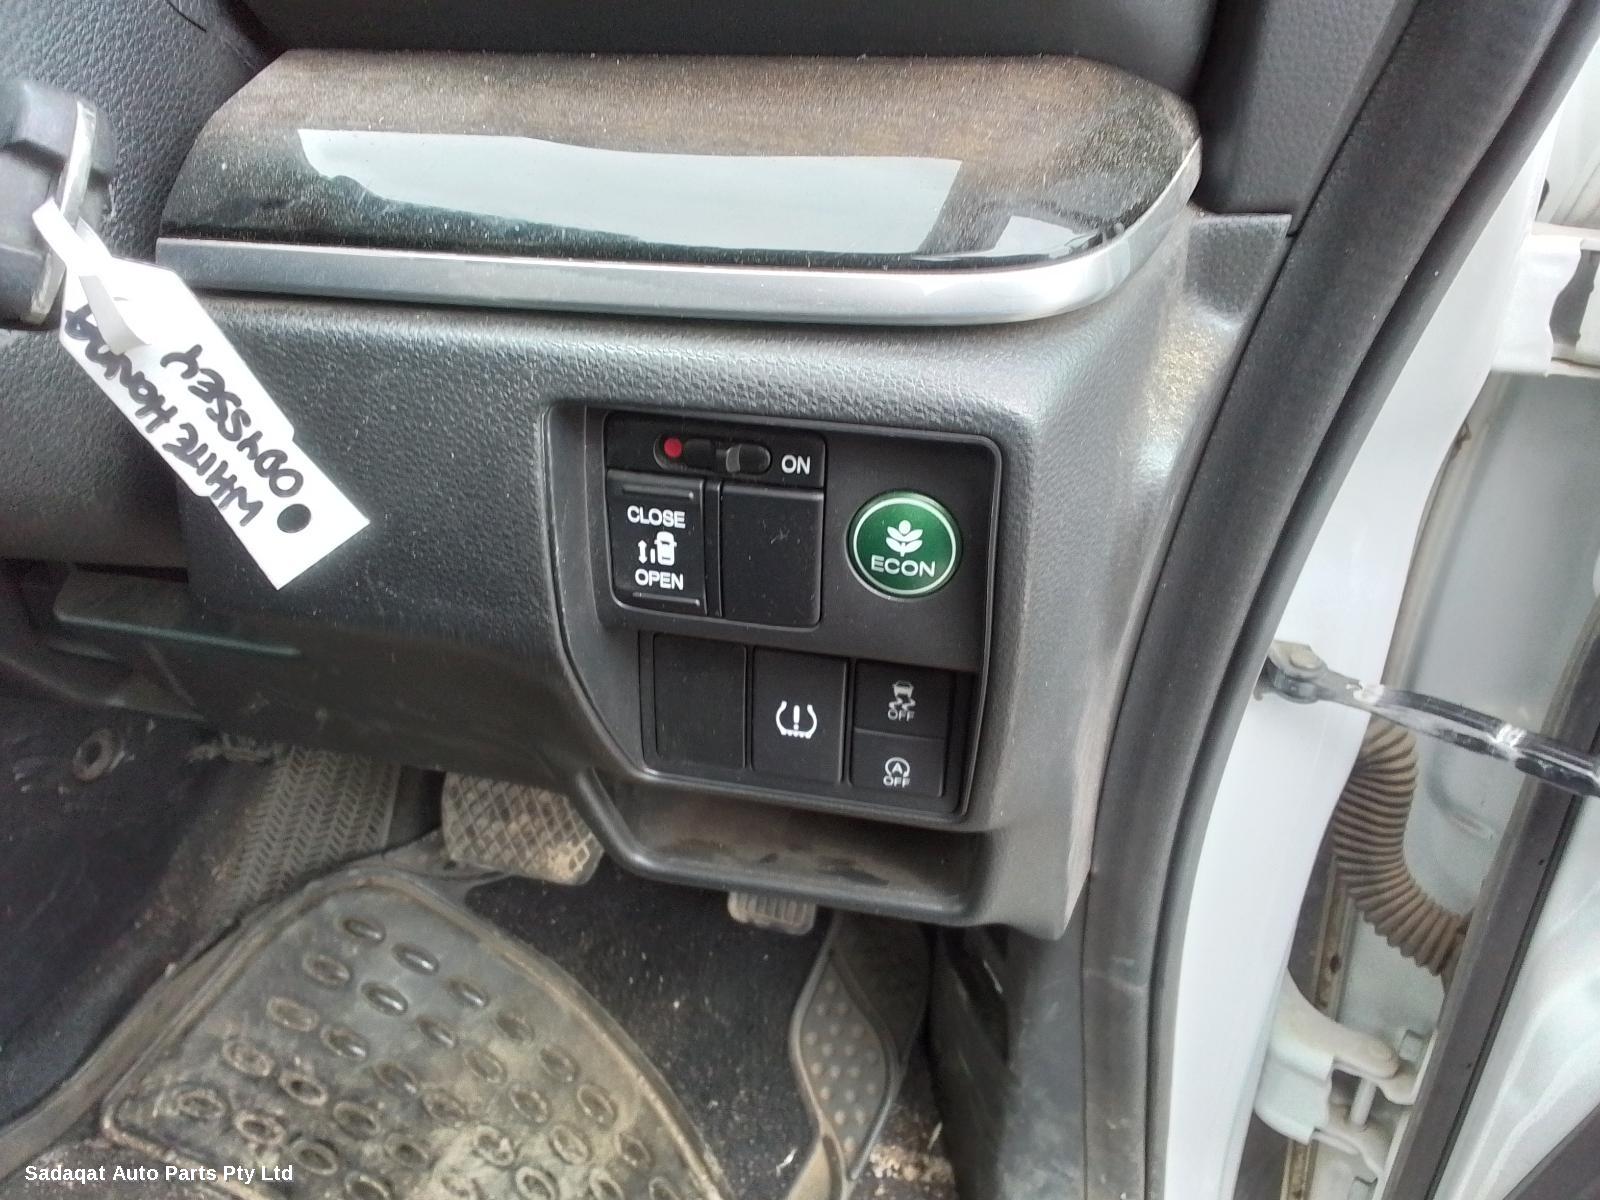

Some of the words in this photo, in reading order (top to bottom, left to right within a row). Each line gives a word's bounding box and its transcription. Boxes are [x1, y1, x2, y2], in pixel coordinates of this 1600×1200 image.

[160, 344, 304, 498] ODYSSEY
[162, 422, 264, 527] WHITE
[781, 454, 811, 476] ON
[626, 505, 686, 529] CLOSE
[871, 554, 936, 578] ECON
[634, 568, 684, 591] OPEN
[887, 709, 915, 721] OFF
[883, 775, 910, 788] OFF
